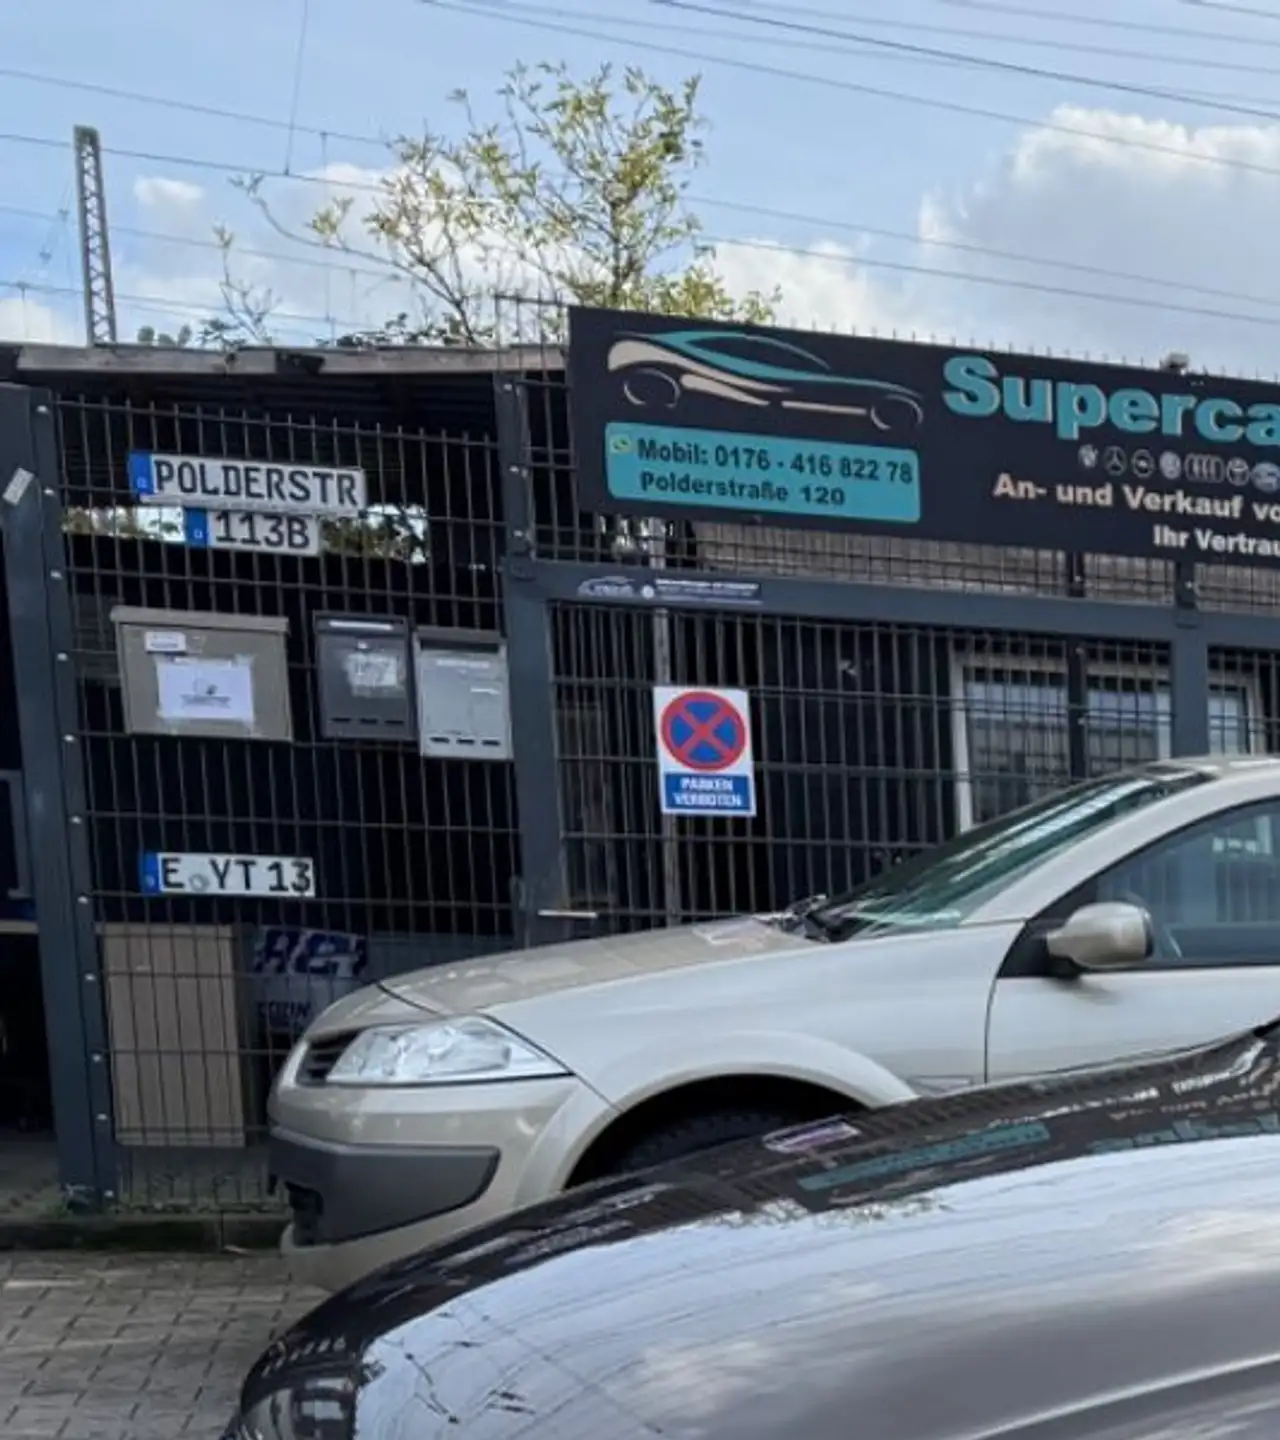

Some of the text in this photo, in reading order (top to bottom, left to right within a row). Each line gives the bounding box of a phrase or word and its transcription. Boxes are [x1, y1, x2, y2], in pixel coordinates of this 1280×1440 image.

[638, 437, 709, 466] Mobil:
[714, 444, 770, 471] 0176
[790, 451, 832, 477] 416
[840, 455, 880, 481] 822
[886, 460, 913, 485] 78
[153, 459, 358, 506] POLDERSTR
[640, 470, 846, 506] Polderstraße 120
[993, 472, 1047, 498] An-
[1056, 482, 1113, 507] und
[1122, 484, 1244, 518] Verkauf
[215, 510, 311, 549] 113B
[1153, 524, 1189, 549] Ihr
[674, 792, 742, 807] VERBOTEN
[680, 777, 733, 791] PARKEN
[161, 857, 311, 893] E YT 13
